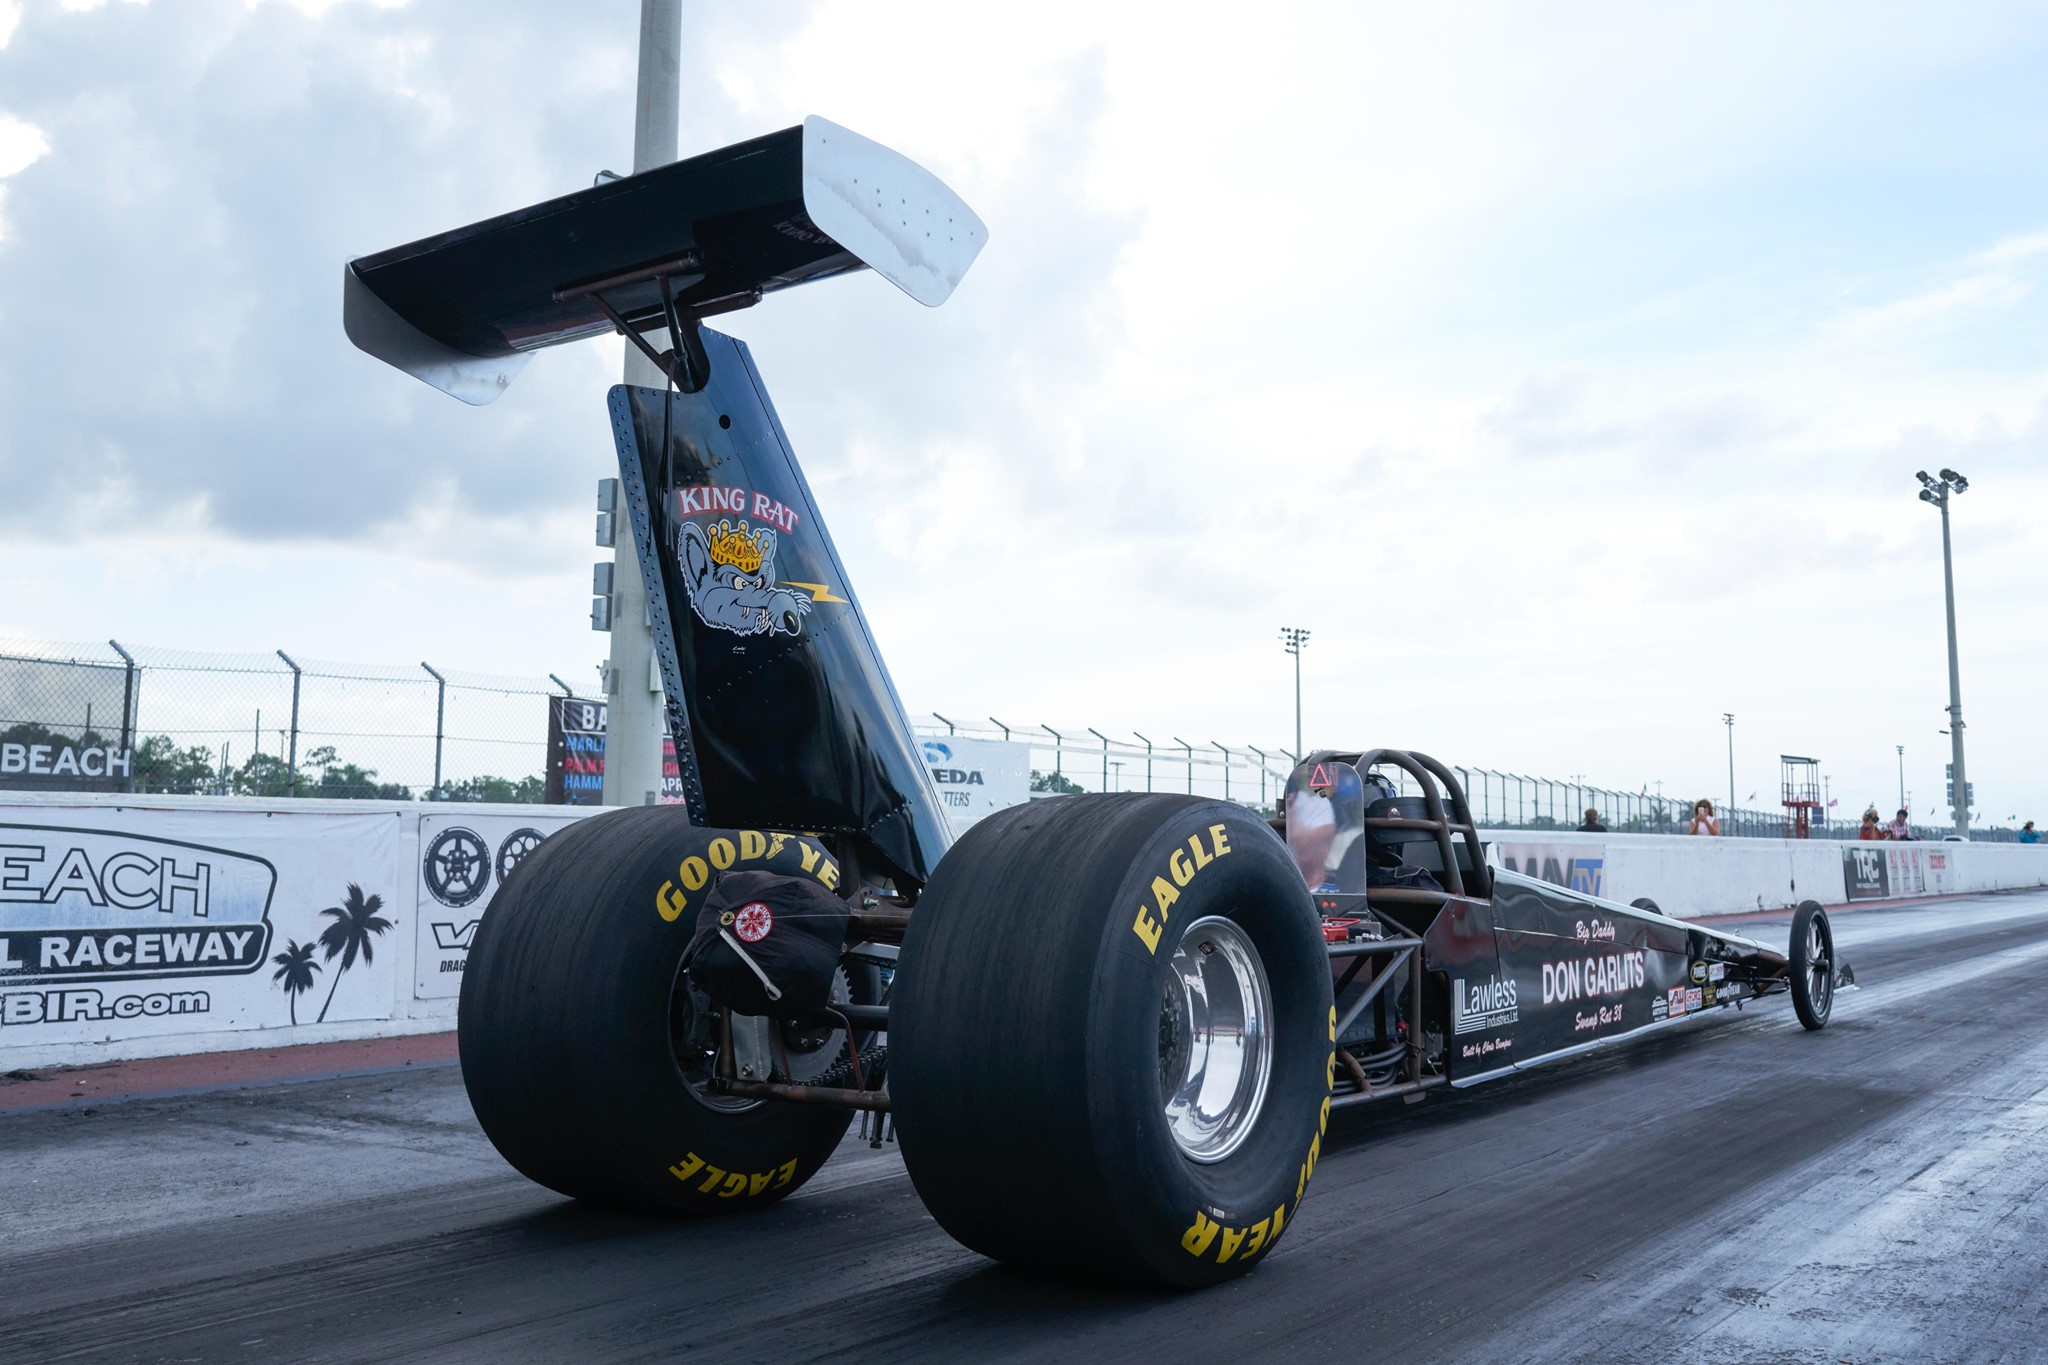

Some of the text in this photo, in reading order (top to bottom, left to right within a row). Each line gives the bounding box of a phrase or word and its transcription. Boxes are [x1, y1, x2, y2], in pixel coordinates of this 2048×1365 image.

[678, 486, 798, 534] KING RAT
[582, 704, 607, 731] BA
[1, 743, 131, 777] BEACH
[566, 736, 606, 752] MARLI
[564, 757, 597, 773] PALM
[931, 768, 984, 786] EDA
[563, 774, 604, 790] HAMM
[661, 777, 684, 791] APR
[941, 791, 970, 807] TTERS
[0, 844, 211, 918] EACH
[656, 830, 841, 922] GOODYE
[1852, 850, 1880, 882] TRC
[1132, 823, 1232, 956] EAGLE
[1575, 919, 1616, 945] Big Daddy
[40, 930, 254, 968] RACEWAY
[1542, 950, 1644, 1005] DON GARLITS
[0, 990, 210, 1027] BIR.com
[1462, 974, 1517, 1015] Lawless
[1575, 1011, 1598, 1031] Swamp
[1599, 1006, 1613, 1025] Rat
[668, 1151, 798, 1198] EAGLE
